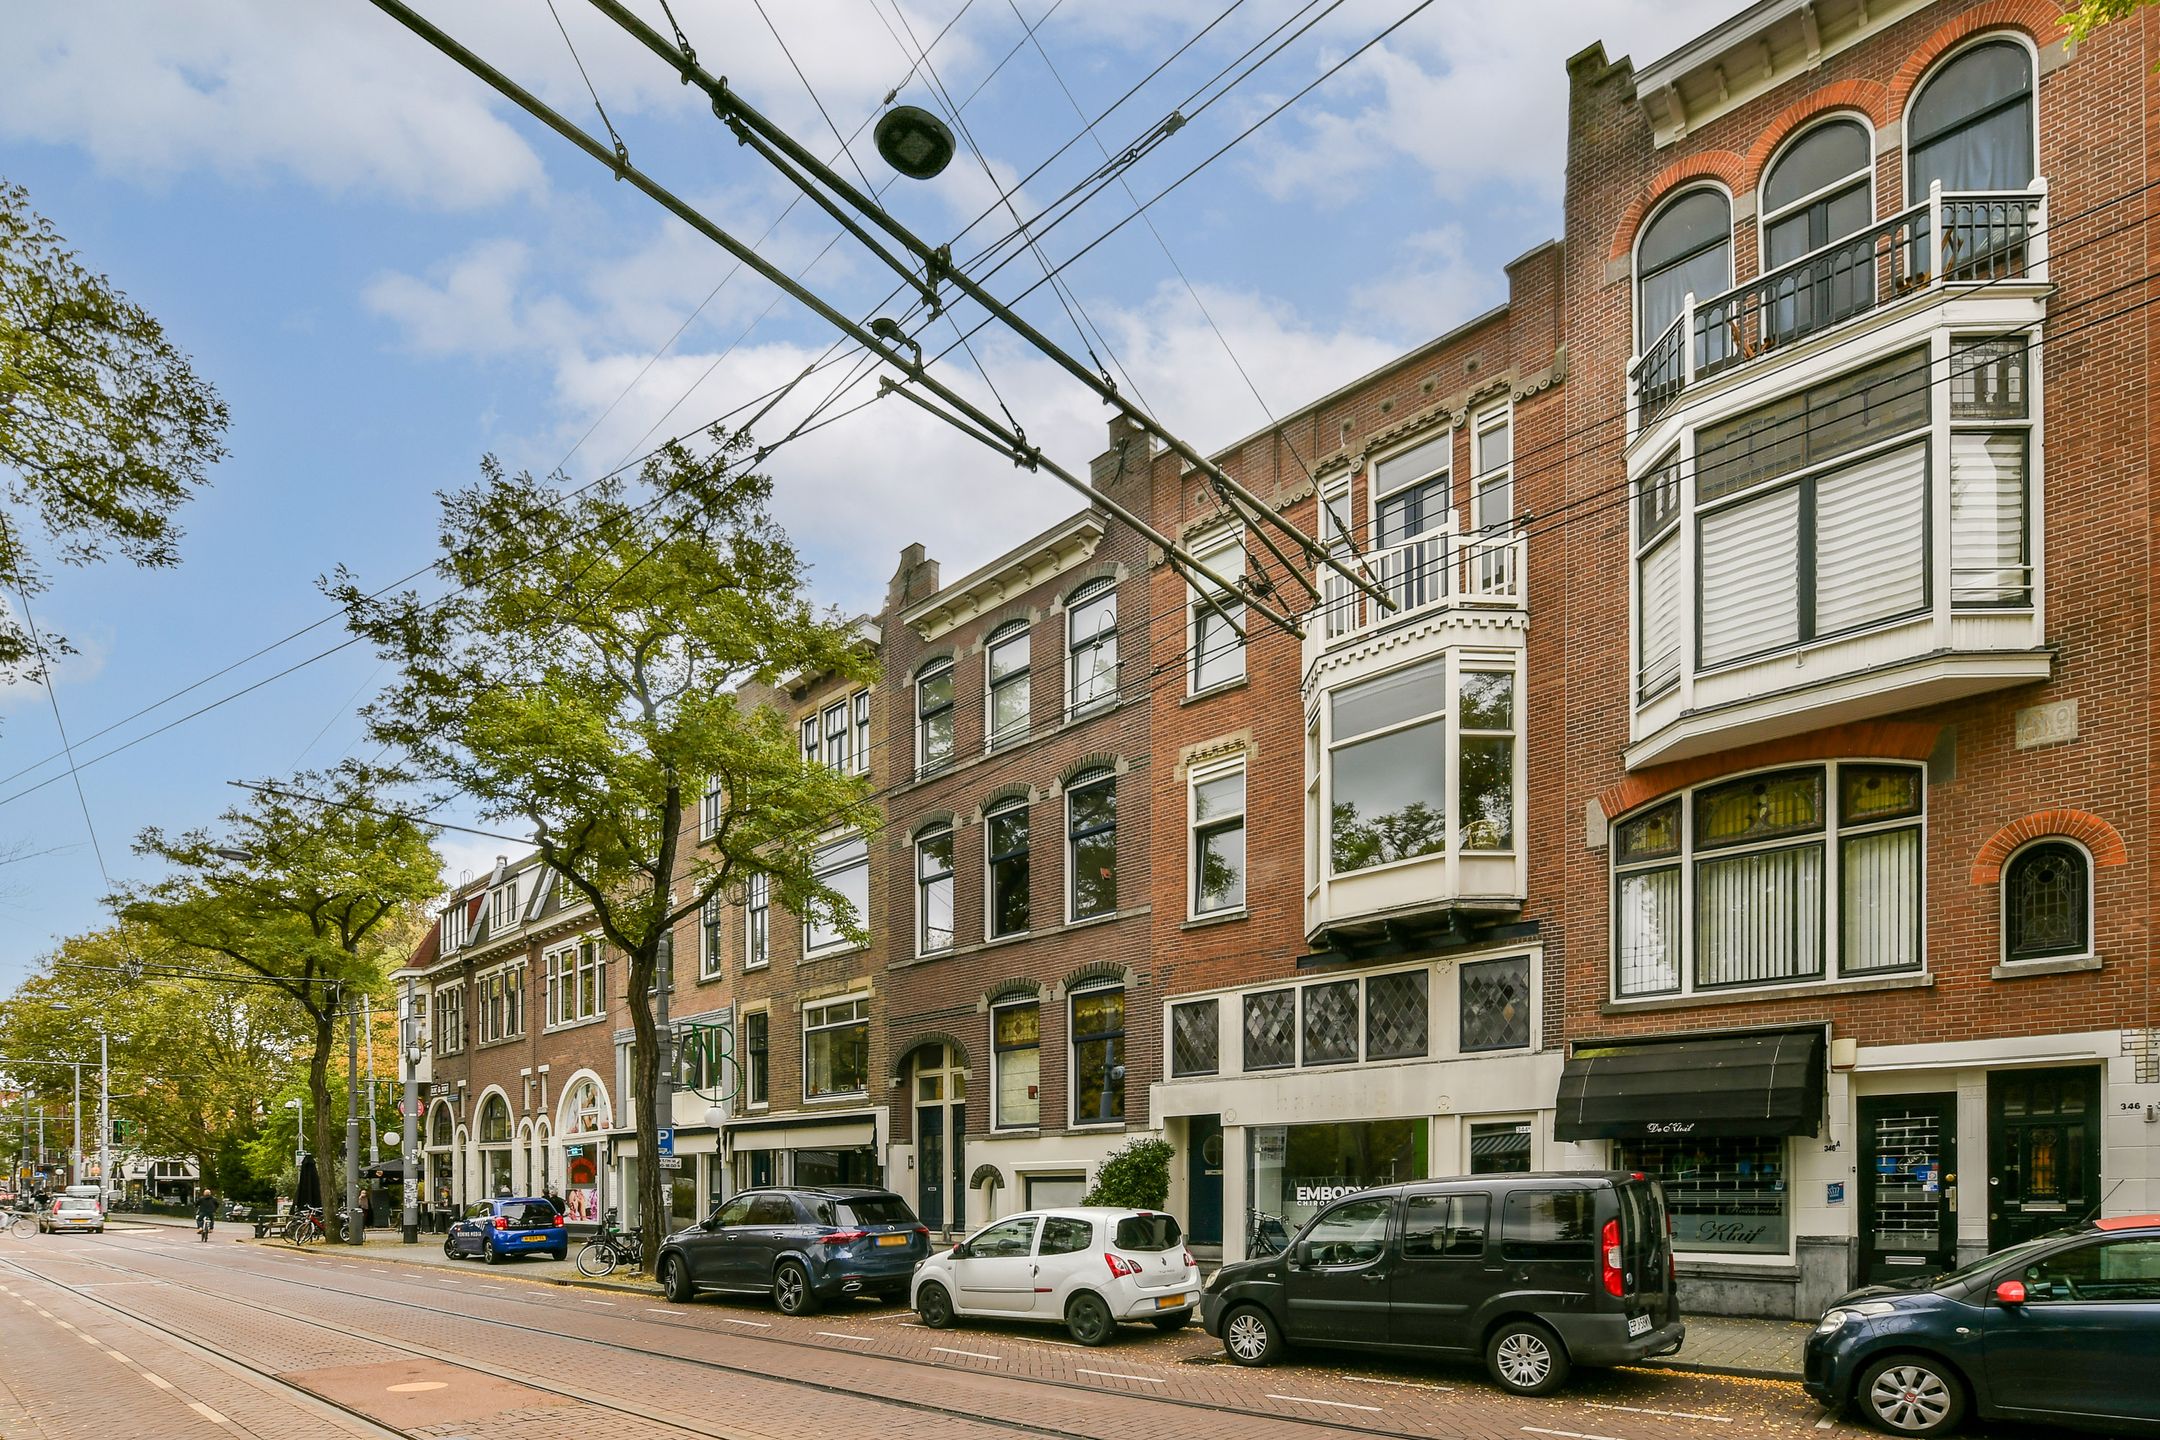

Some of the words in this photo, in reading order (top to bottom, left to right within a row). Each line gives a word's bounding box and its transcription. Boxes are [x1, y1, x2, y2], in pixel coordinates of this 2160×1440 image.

[2120, 1102, 2141, 1110] 346
[657, 1130, 669, 1145] P
[1700, 1220, 1767, 1243] Kluif
